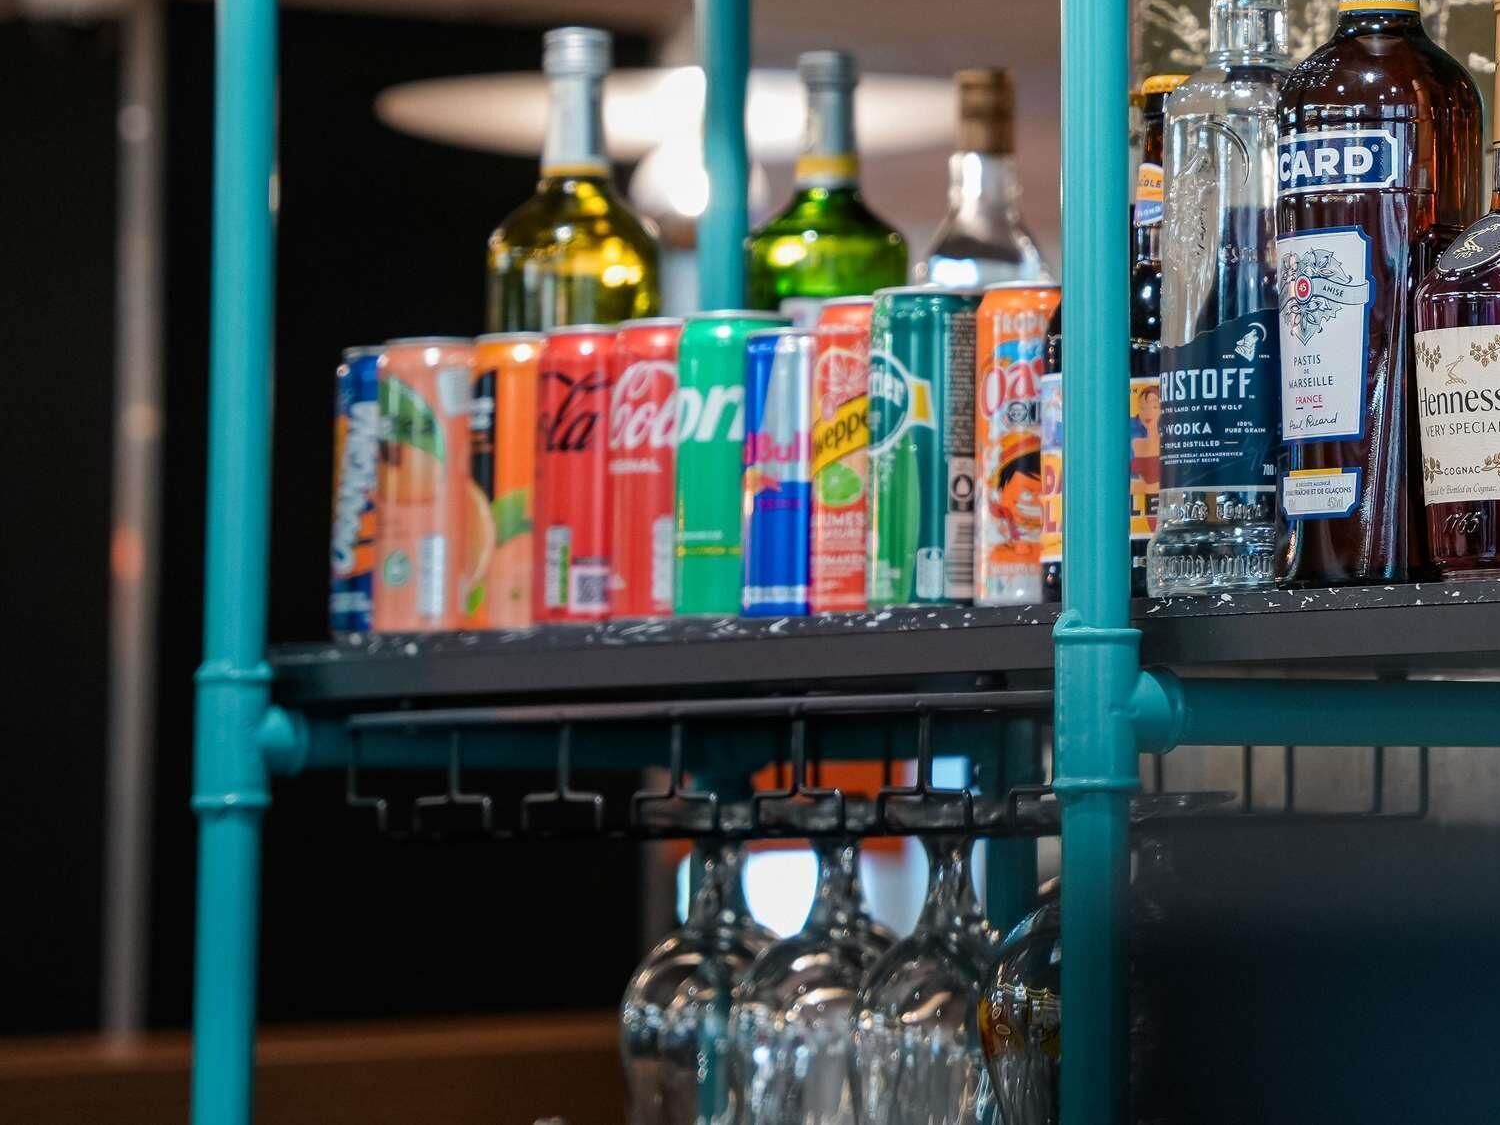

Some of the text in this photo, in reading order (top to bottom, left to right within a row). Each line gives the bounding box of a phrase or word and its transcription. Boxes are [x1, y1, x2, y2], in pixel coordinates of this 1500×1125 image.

[1294, 354, 1321, 368] PASTIS
[1160, 367, 1256, 402] RISTOFF
[1288, 375, 1335, 389] MARSEILLE
[1295, 394, 1323, 405] FRANCE
[1191, 404, 1201, 412] OF
[1305, 411, 1338, 428] Ricard
[1166, 422, 1212, 435] VODKA
[1425, 424, 1446, 438] VERY
[1183, 440, 1220, 448] DISTILLED
[1444, 465, 1481, 476] COGNAC
